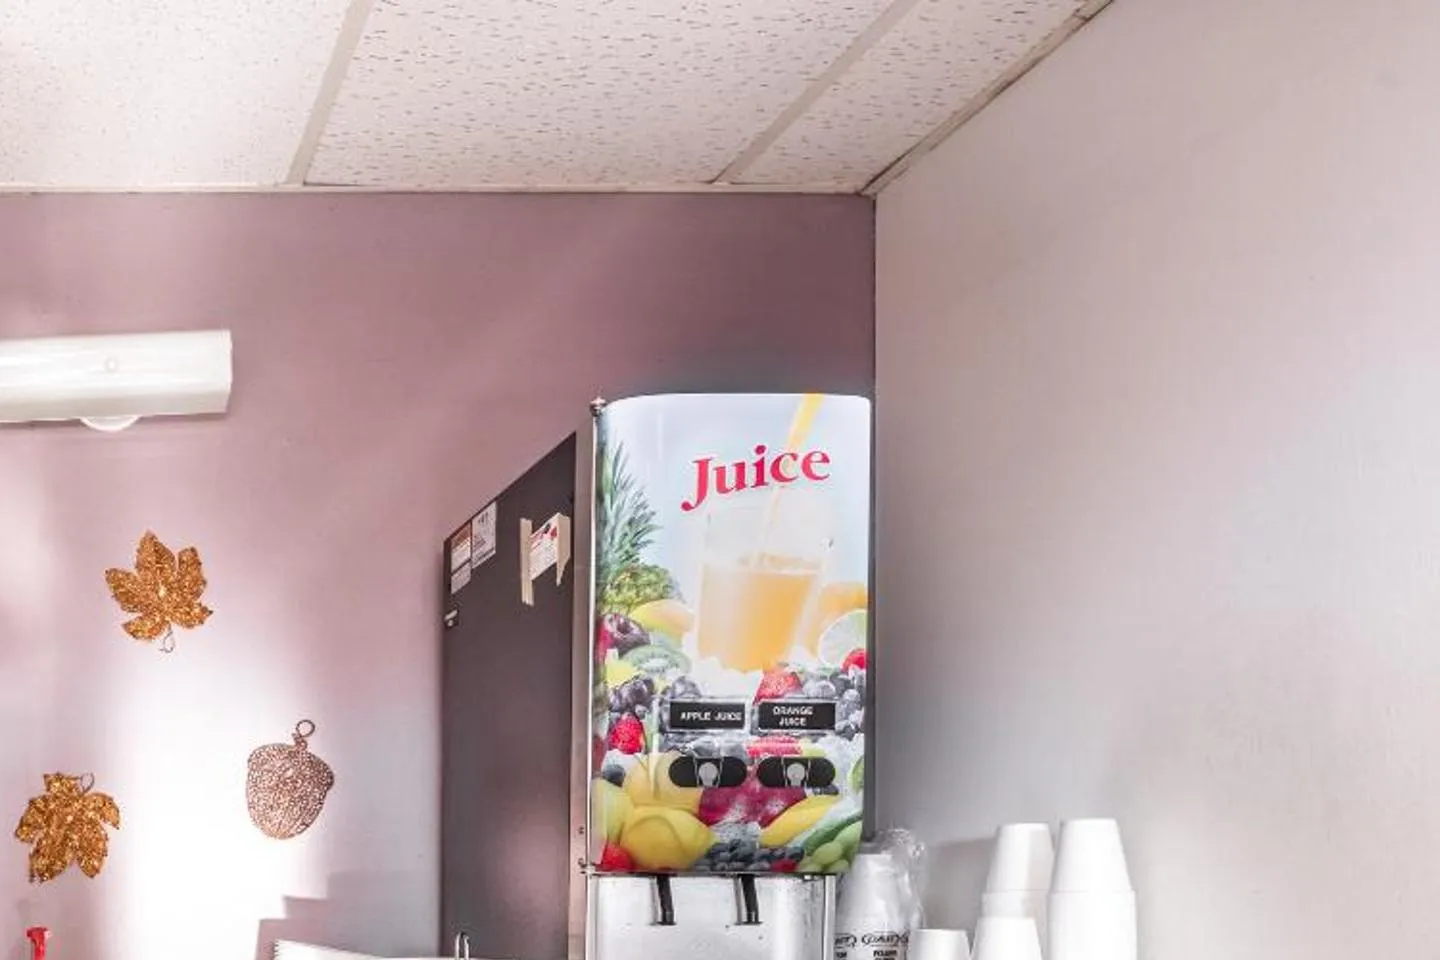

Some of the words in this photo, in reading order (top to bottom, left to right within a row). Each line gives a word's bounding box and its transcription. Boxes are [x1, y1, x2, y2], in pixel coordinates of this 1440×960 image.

[680, 444, 831, 512] Juice
[772, 705, 814, 716] ORANGE
[679, 711, 711, 721] APPLE
[714, 711, 743, 722] JUICE
[778, 717, 807, 727] JUICE
